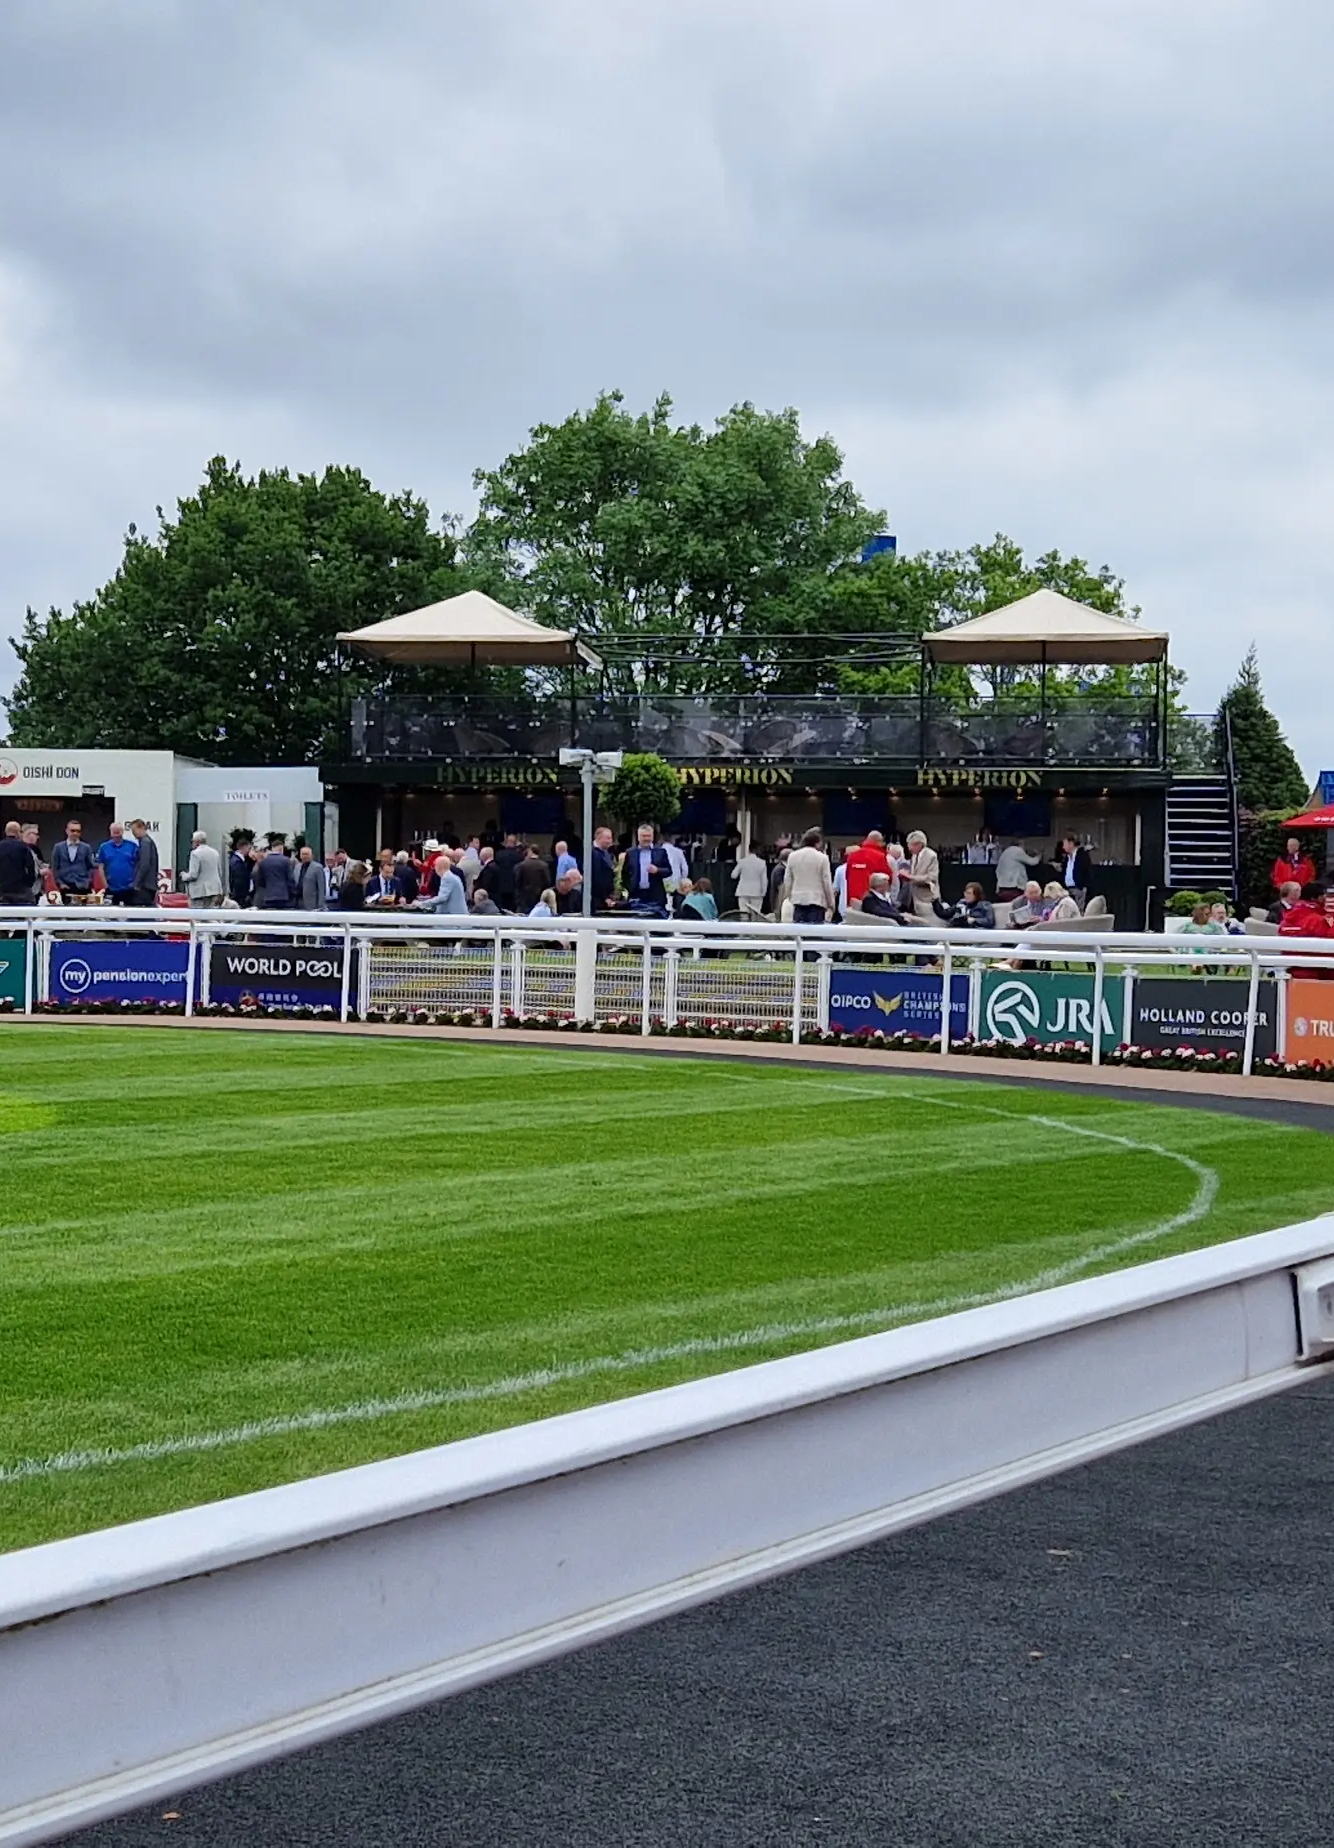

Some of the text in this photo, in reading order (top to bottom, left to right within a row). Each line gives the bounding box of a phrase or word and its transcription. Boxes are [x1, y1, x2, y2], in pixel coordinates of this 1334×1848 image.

[56, 766, 79, 779] DON
[436, 766, 558, 784] HYPERION
[672, 767, 794, 785] HYPERION
[916, 769, 1044, 787] HYPERION
[226, 956, 343, 979] WORLD POOL
[64, 969, 87, 985] my
[1139, 1007, 1205, 1024] HOLLAND
